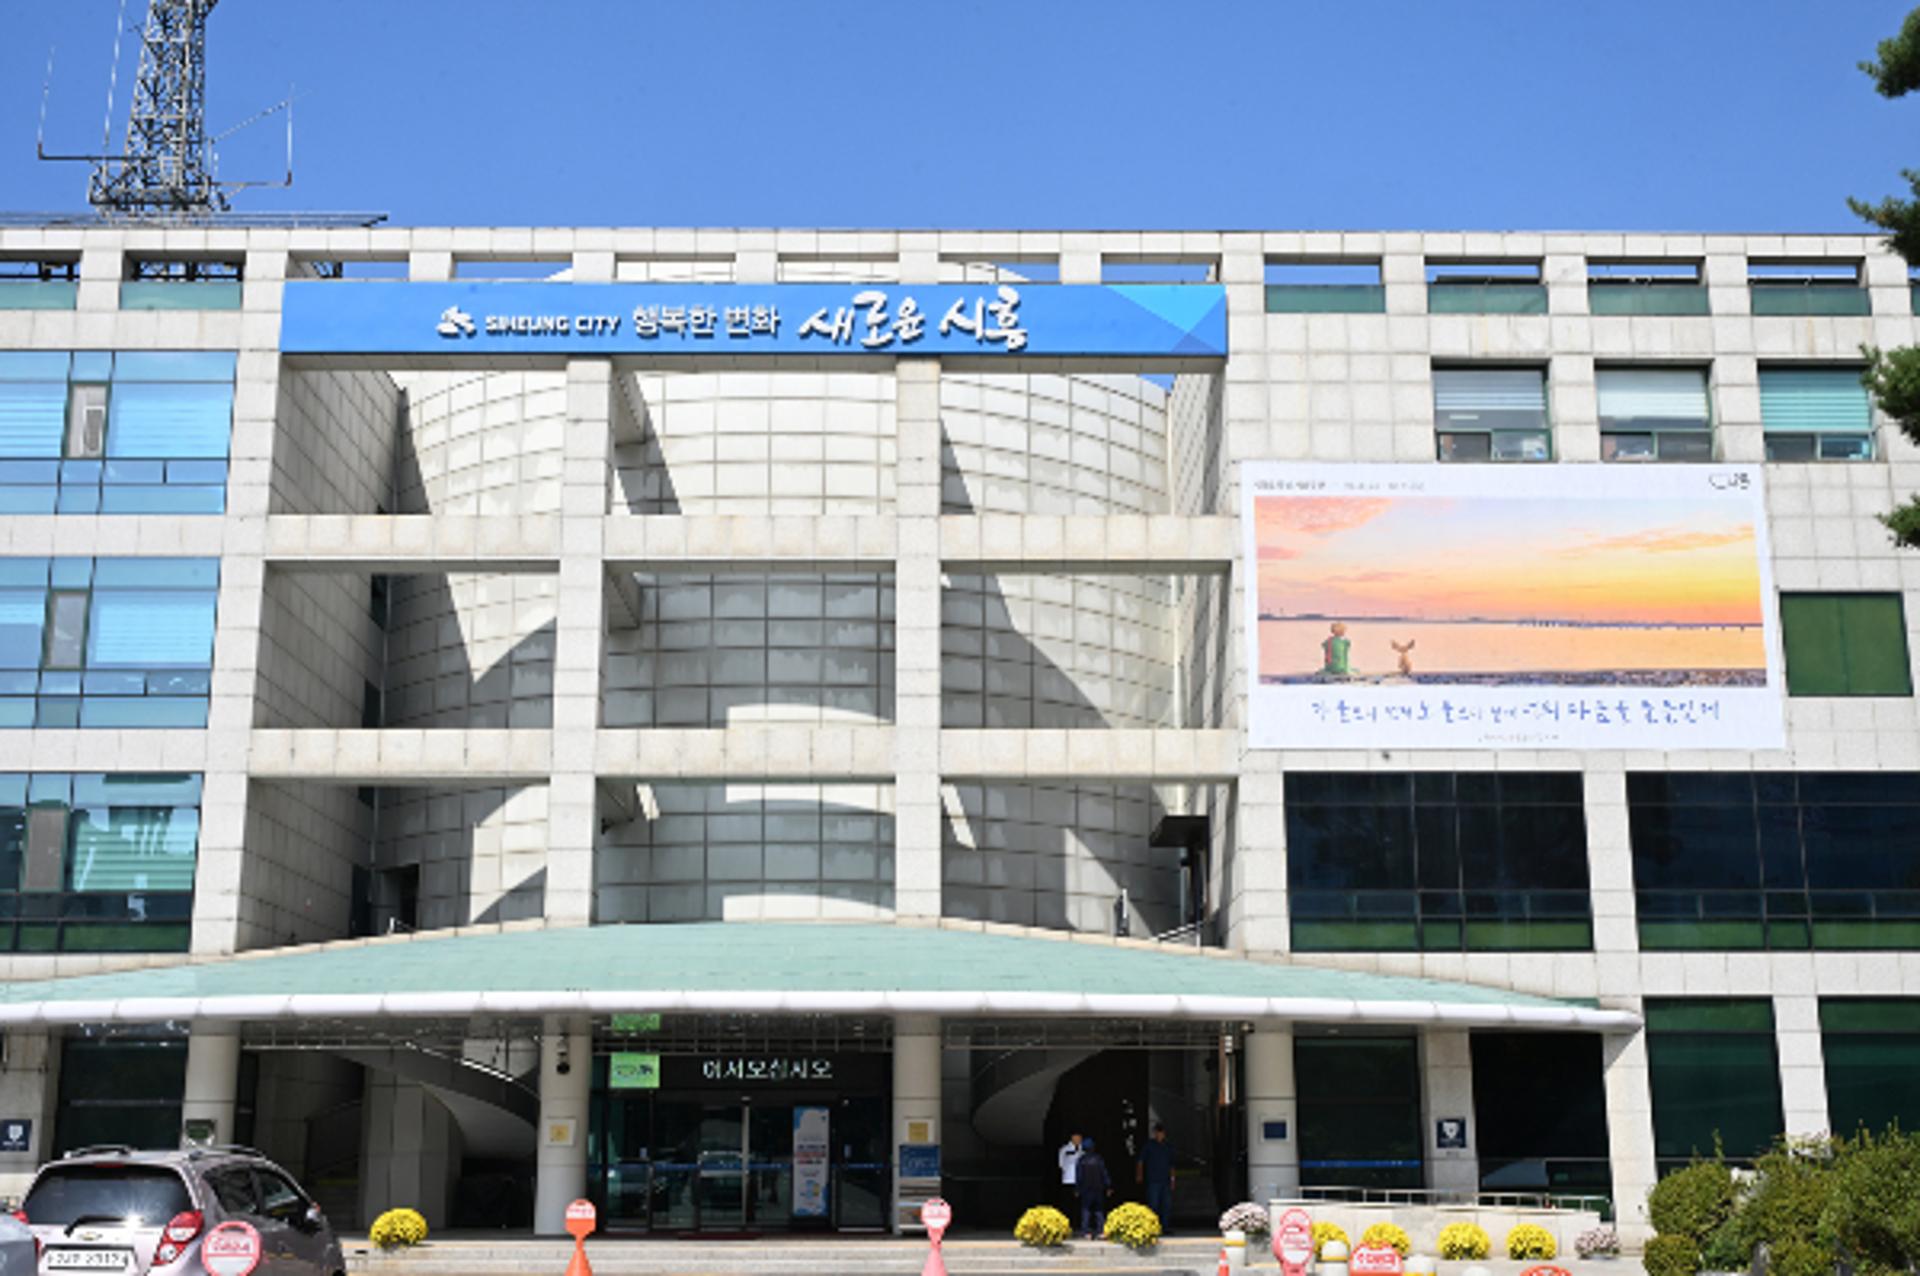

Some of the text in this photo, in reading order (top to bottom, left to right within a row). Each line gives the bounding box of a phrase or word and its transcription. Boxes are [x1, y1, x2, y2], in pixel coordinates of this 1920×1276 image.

[575, 315, 621, 331] CITY
[632, 305, 717, 335] 행복한
[725, 305, 780, 334] 변화
[798, 290, 925, 348] 새로운
[938, 284, 1028, 351] 시흥
[703, 1058, 833, 1080] 어서오십시오
